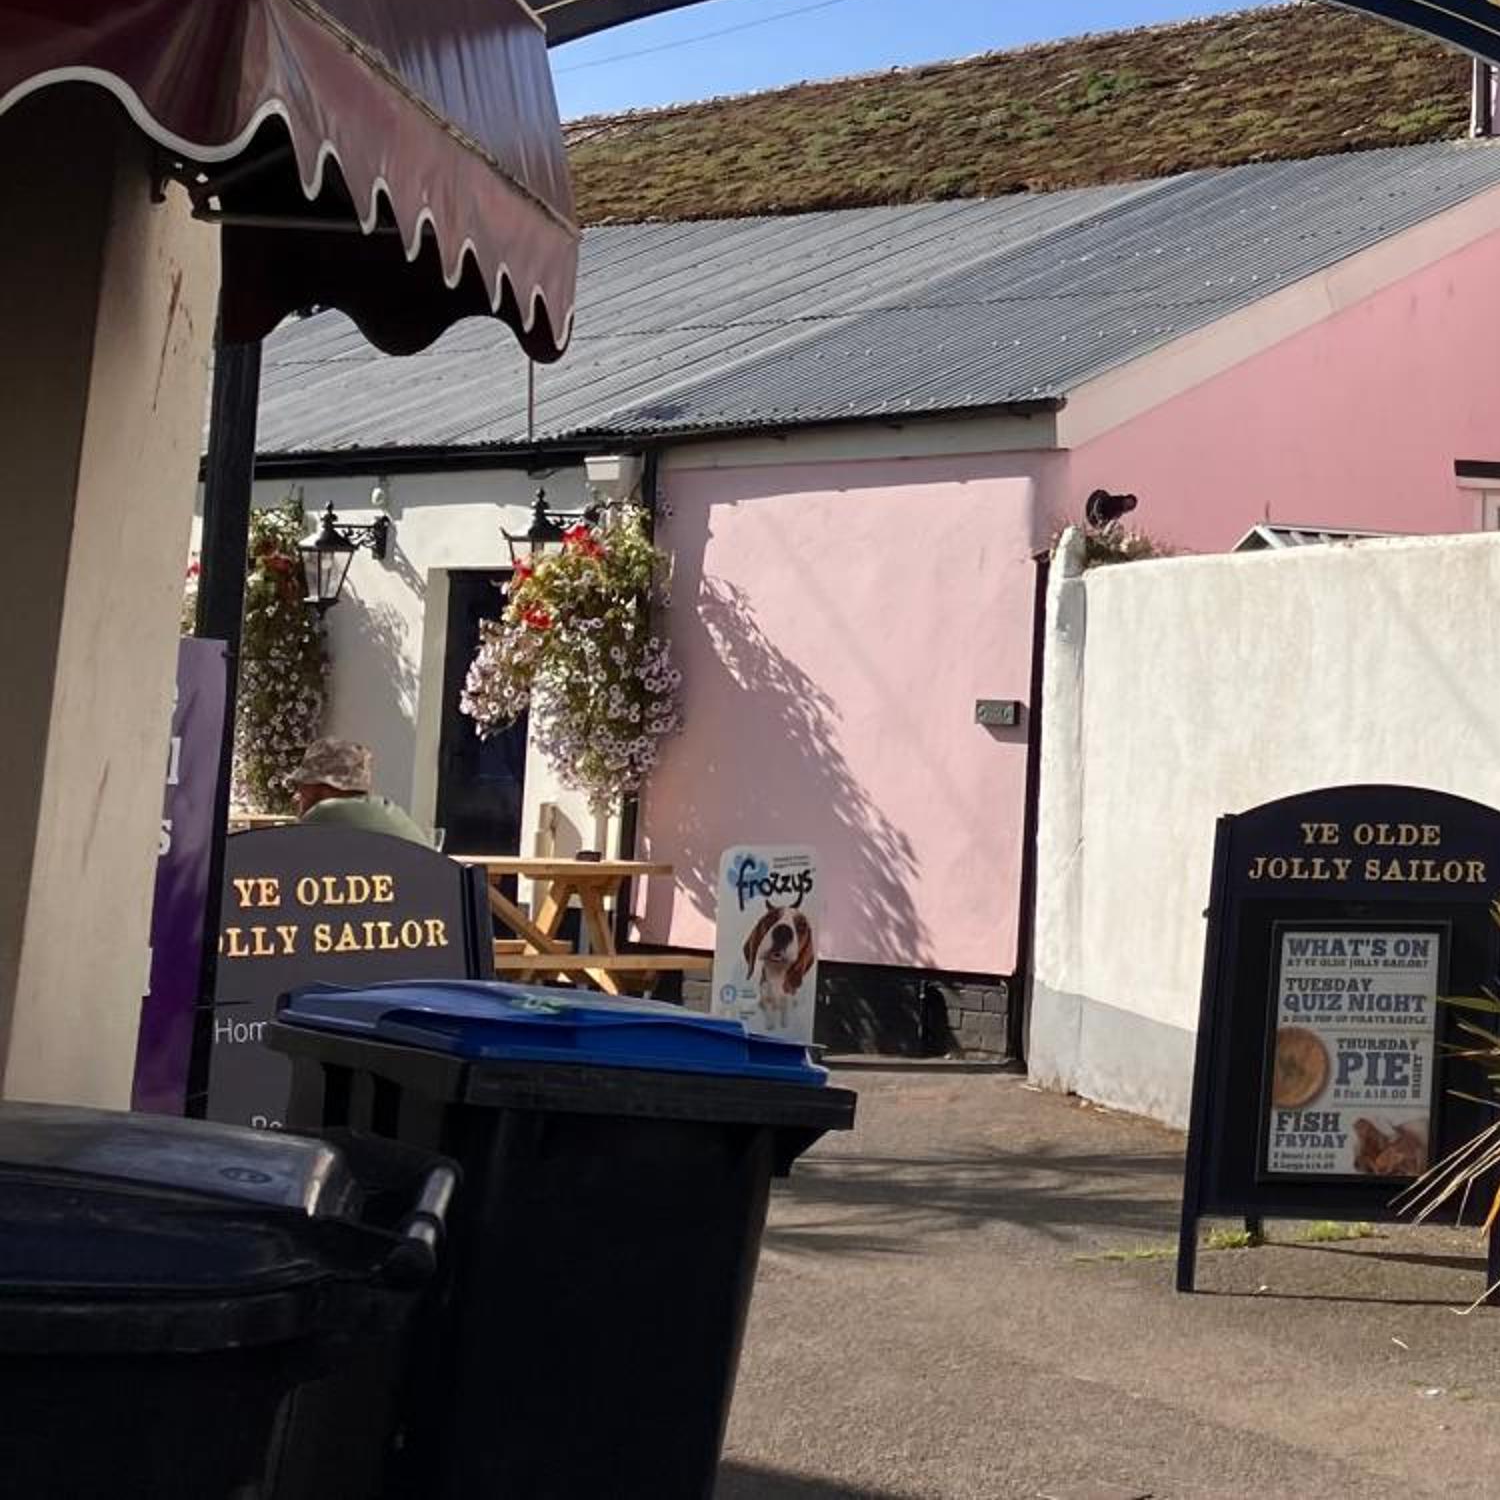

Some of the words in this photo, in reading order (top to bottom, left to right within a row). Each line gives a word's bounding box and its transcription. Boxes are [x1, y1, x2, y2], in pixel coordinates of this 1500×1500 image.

[1301, 822, 1339, 845] YE
[1353, 823, 1442, 846] OLDE
[1248, 856, 1352, 881] JOLLY
[1364, 858, 1487, 883] SAILOR
[233, 877, 282, 908] YE
[296, 874, 395, 906] OLDE
[219, 925, 299, 957] LLY
[313, 918, 449, 953] SAILOR
[1287, 938, 1388, 957] WHAT'S
[1394, 939, 1431, 957] ON
[1285, 977, 1373, 992] TUESDAY
[1283, 993, 1343, 1013] QUIZ
[1348, 994, 1428, 1013] NIGHT
[1336, 1038, 1420, 1050] THURSDAY
[1336, 1051, 1411, 1087] PIE
[1275, 1111, 1342, 1132] FISH
[1275, 1133, 1347, 1148] FRYDAY
